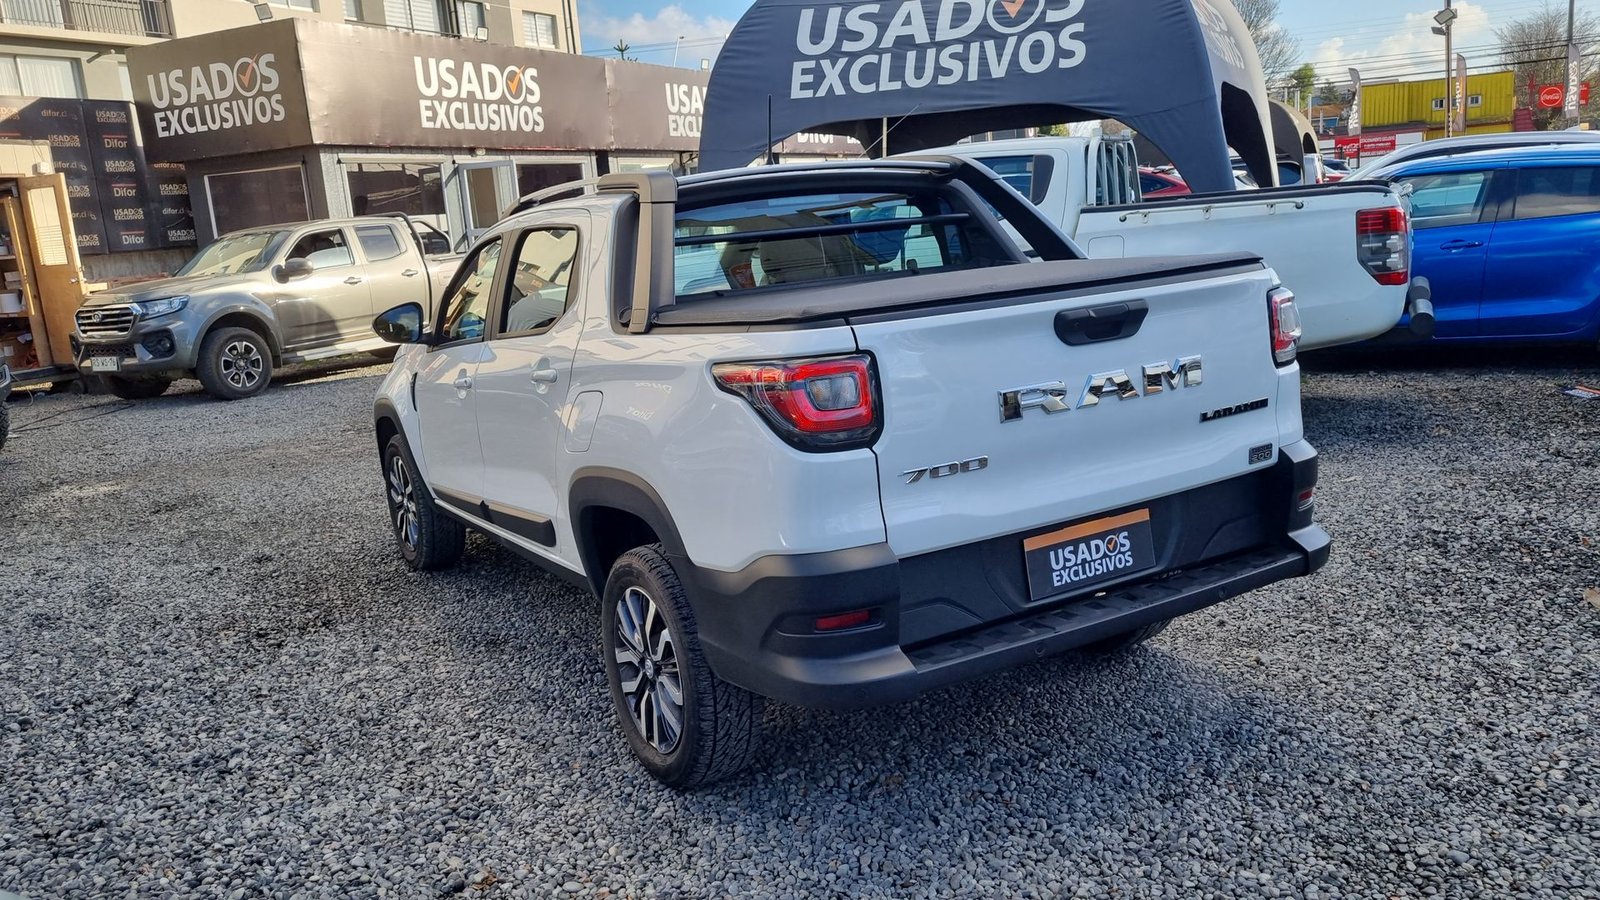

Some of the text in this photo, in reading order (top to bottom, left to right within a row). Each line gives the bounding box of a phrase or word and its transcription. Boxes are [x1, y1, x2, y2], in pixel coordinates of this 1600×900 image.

[790, 23, 1086, 99] EXCLUSIVOS
[147, 53, 279, 109] USADOS
[414, 56, 541, 104] USADOS
[96, 110, 126, 118] USADOS
[154, 94, 285, 138] EXCLUSIVOS
[419, 99, 544, 133] EXCLUSIVOS
[105, 138, 127, 148] Difor
[114, 187, 136, 197] Difor
[122, 234, 144, 245] Difor
[998, 354, 1202, 423] RAM
[897, 455, 988, 484] 700
[1050, 531, 1130, 570] USADOS
[1053, 551, 1133, 586] EXCLUSIVOS
